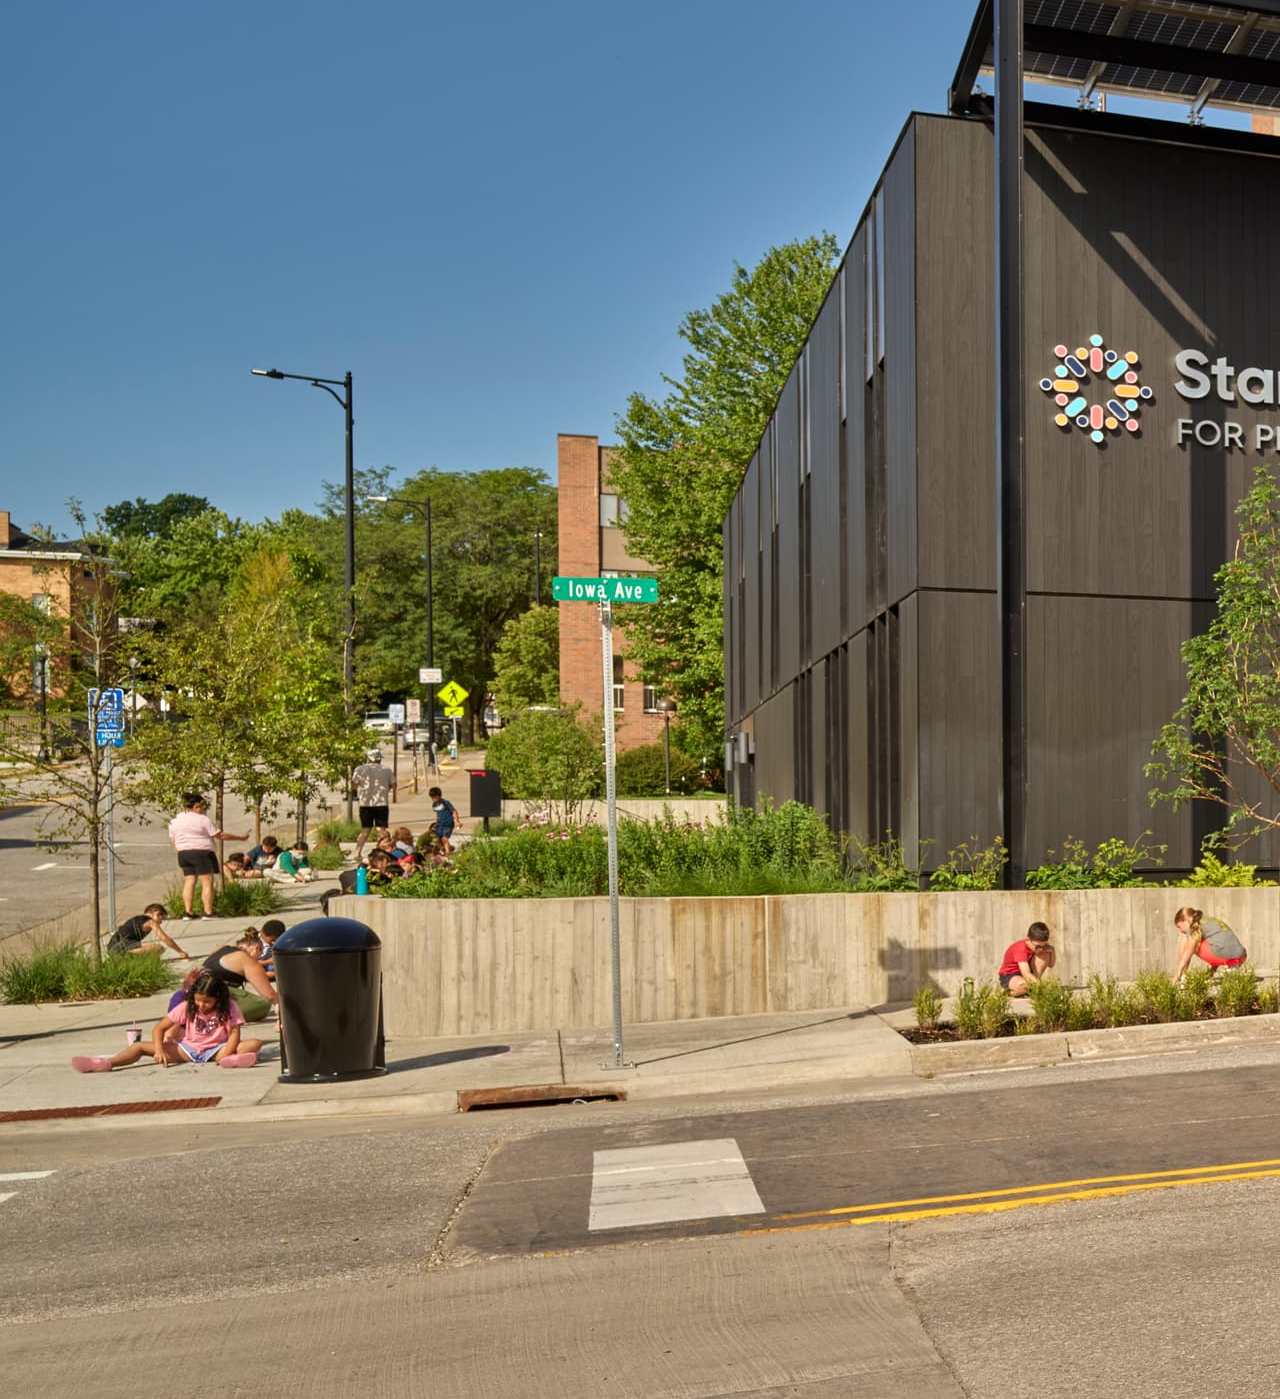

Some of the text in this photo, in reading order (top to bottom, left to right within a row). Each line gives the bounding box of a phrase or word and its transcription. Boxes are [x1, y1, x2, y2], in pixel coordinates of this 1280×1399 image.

[1177, 418, 1244, 449] FOR
[569, 580, 642, 599] Iowa Ave
